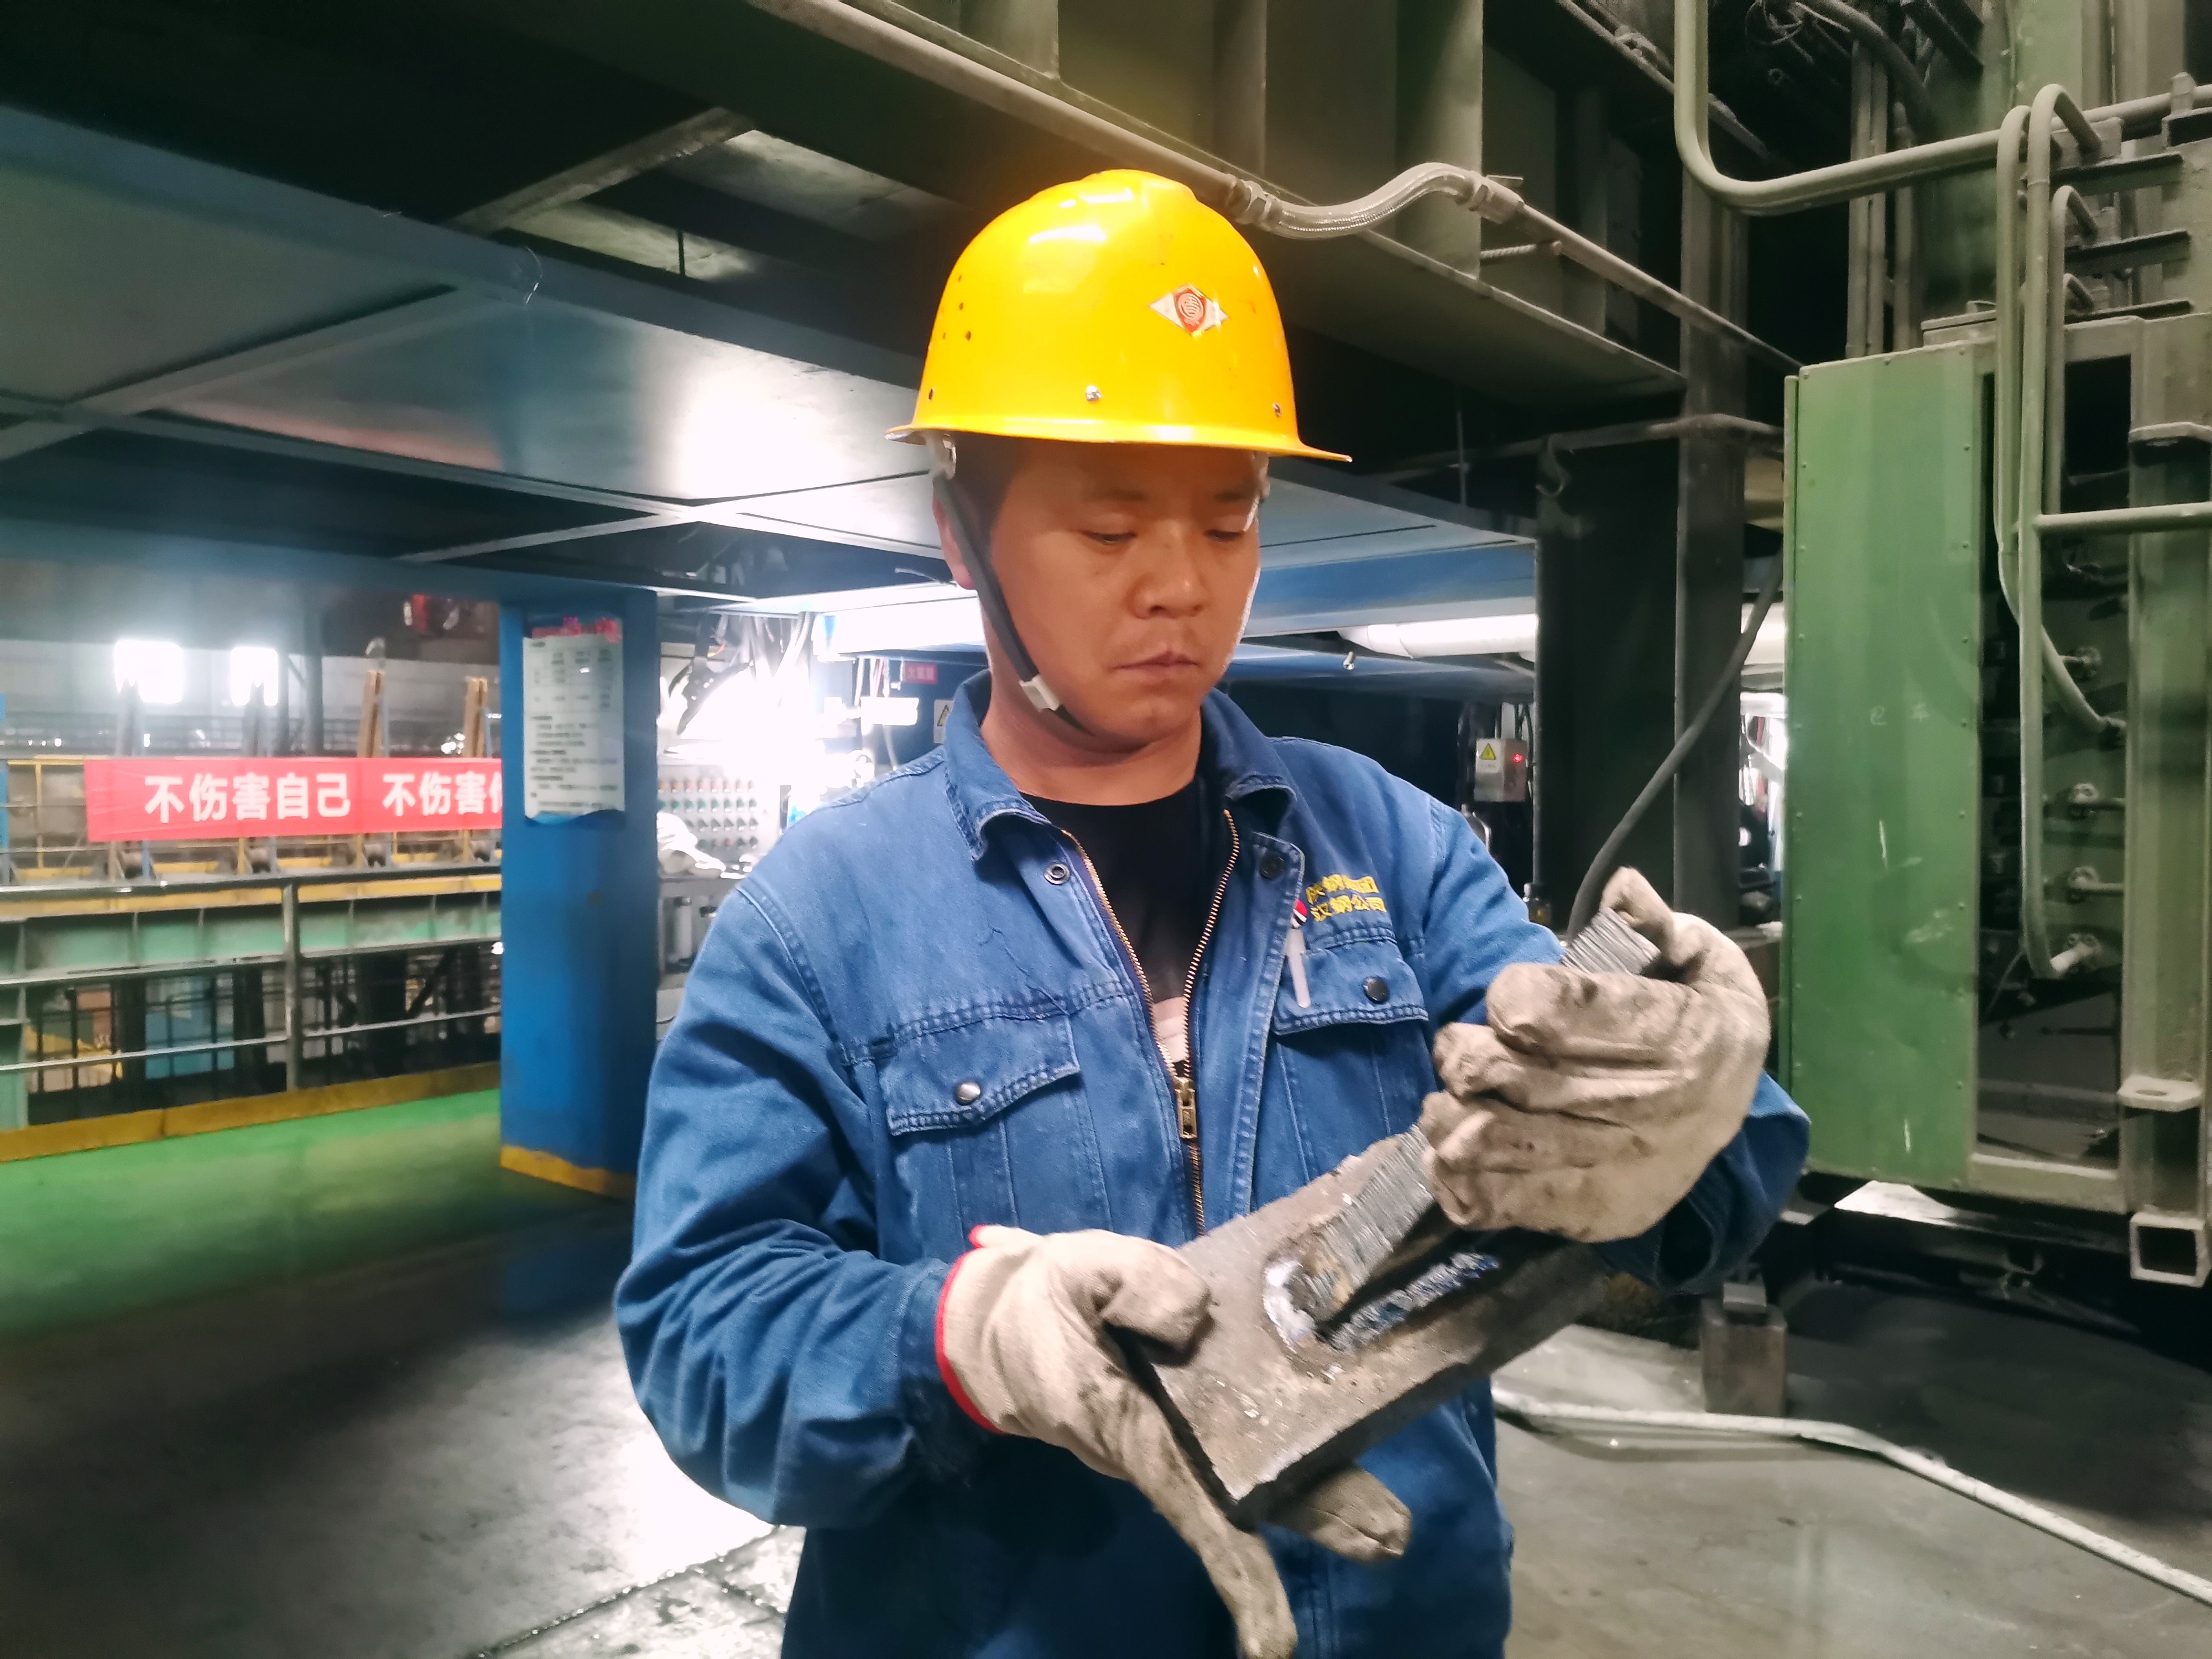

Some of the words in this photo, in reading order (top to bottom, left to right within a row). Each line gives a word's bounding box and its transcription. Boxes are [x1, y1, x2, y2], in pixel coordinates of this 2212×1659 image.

[144, 771, 351, 824] 不伤害自己
